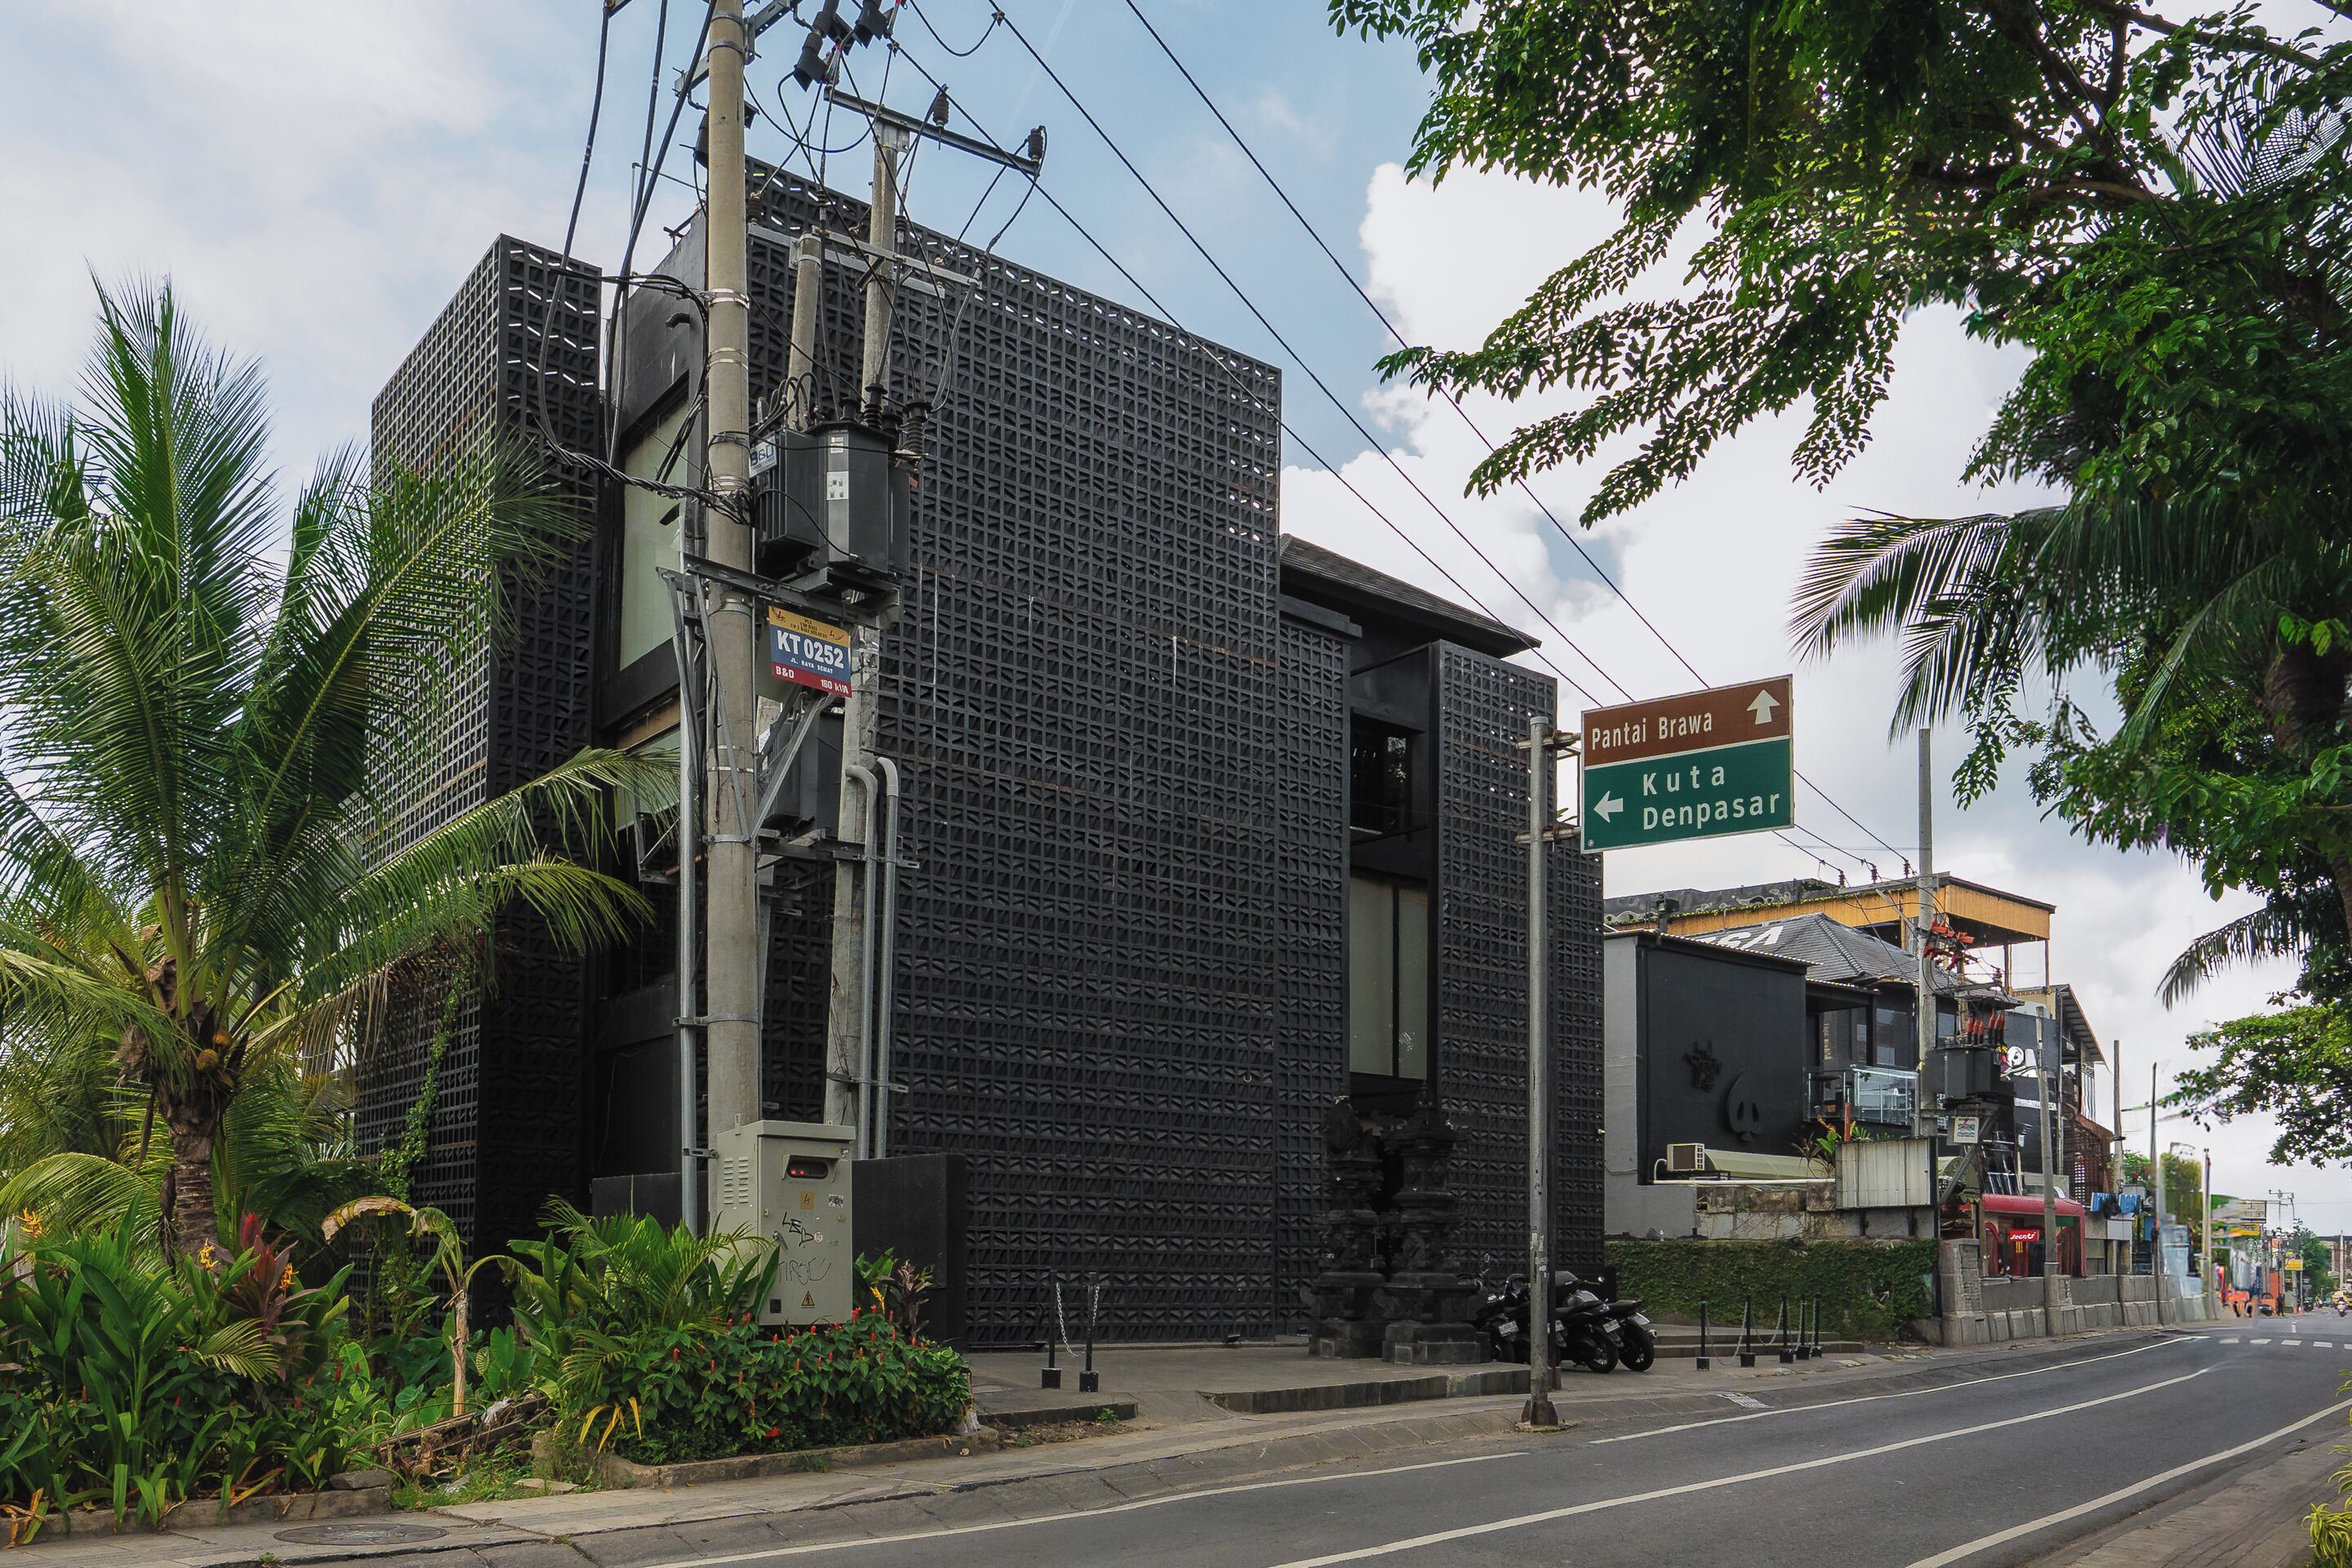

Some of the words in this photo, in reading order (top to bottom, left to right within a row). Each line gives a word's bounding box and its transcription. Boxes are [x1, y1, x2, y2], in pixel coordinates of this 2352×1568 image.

[777, 630, 800, 655] KT
[804, 639, 844, 669] 0252
[801, 660, 815, 669] RAYA
[775, 666, 795, 679] B&D
[820, 679, 833, 689] 160
[835, 683, 849, 694] kVA
[1592, 717, 1647, 750] Pantai
[1659, 712, 1713, 740] Brawa
[1642, 765, 1725, 796] Kuta
[1643, 792, 1780, 830] Denpasar
